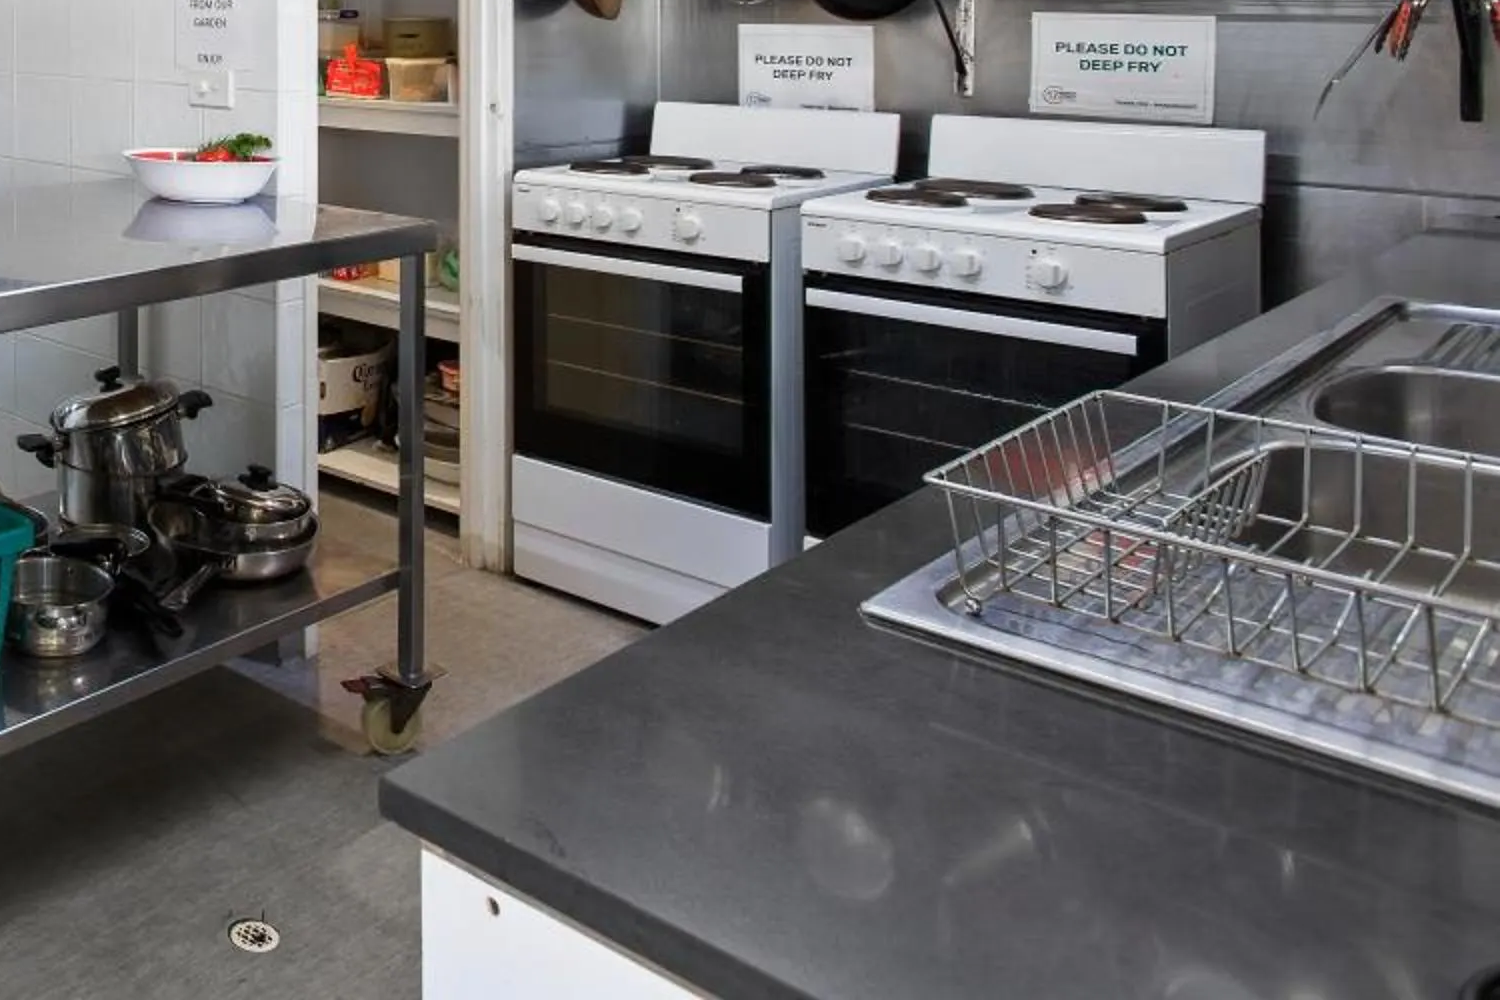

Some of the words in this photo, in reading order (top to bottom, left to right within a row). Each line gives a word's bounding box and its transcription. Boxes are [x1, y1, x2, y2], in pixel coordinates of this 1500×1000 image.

[190, 0, 212, 9] FROM
[214, 0, 233, 9] OUR
[194, 18, 226, 28] GARDEN
[1054, 40, 1119, 55] PLEASE
[1123, 43, 1148, 56] DO
[1152, 44, 1188, 57] NOT
[198, 54, 222, 64] ENJOY
[755, 53, 803, 66] PLEASE
[805, 55, 824, 67] DO
[827, 56, 853, 68] NOT
[1079, 58, 1124, 72] DEEP
[1127, 60, 1162, 73] FRY
[773, 69, 806, 80] DEEP
[809, 70, 833, 81] FRY
